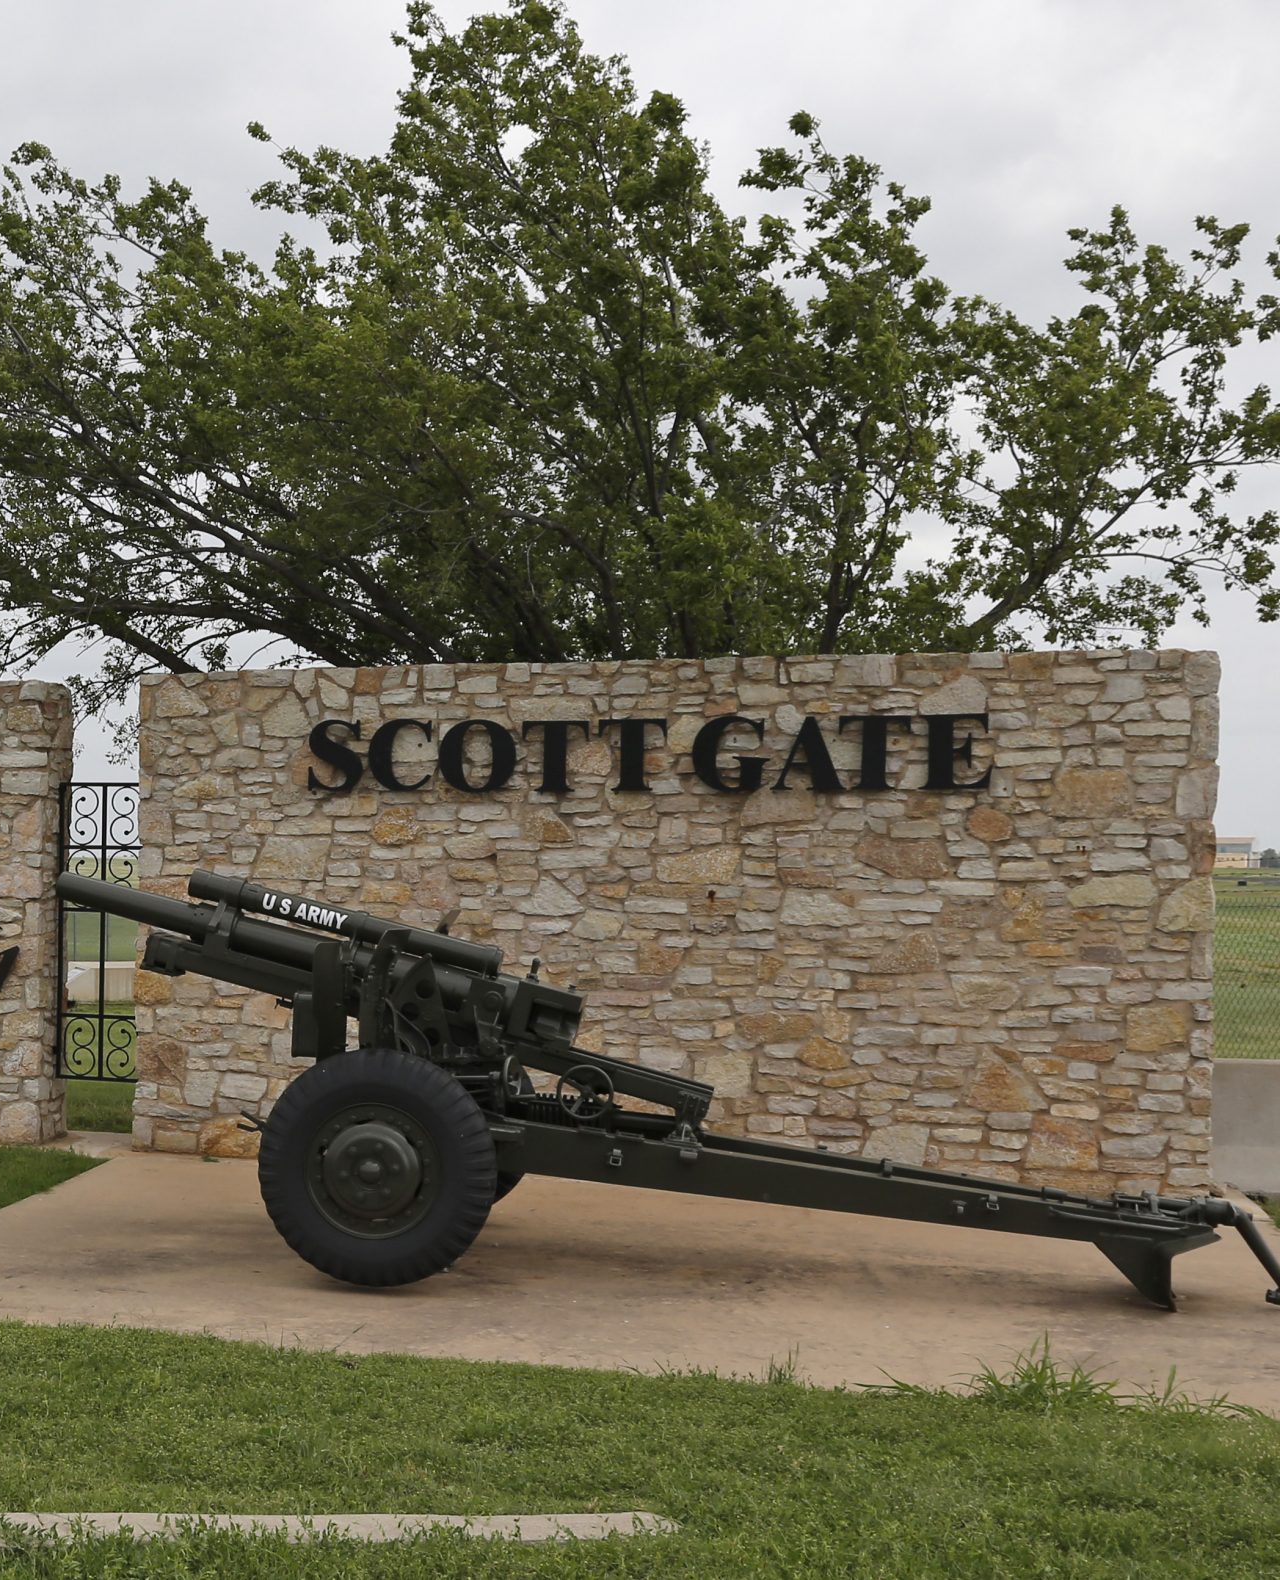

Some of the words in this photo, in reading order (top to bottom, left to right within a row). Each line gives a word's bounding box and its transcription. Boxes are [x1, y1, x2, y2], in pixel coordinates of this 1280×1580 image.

[307, 718, 668, 793] SCOTT
[692, 713, 992, 793] GATE
[262, 893, 277, 910] U
[279, 898, 292, 915] S
[294, 903, 348, 929] ARMY
